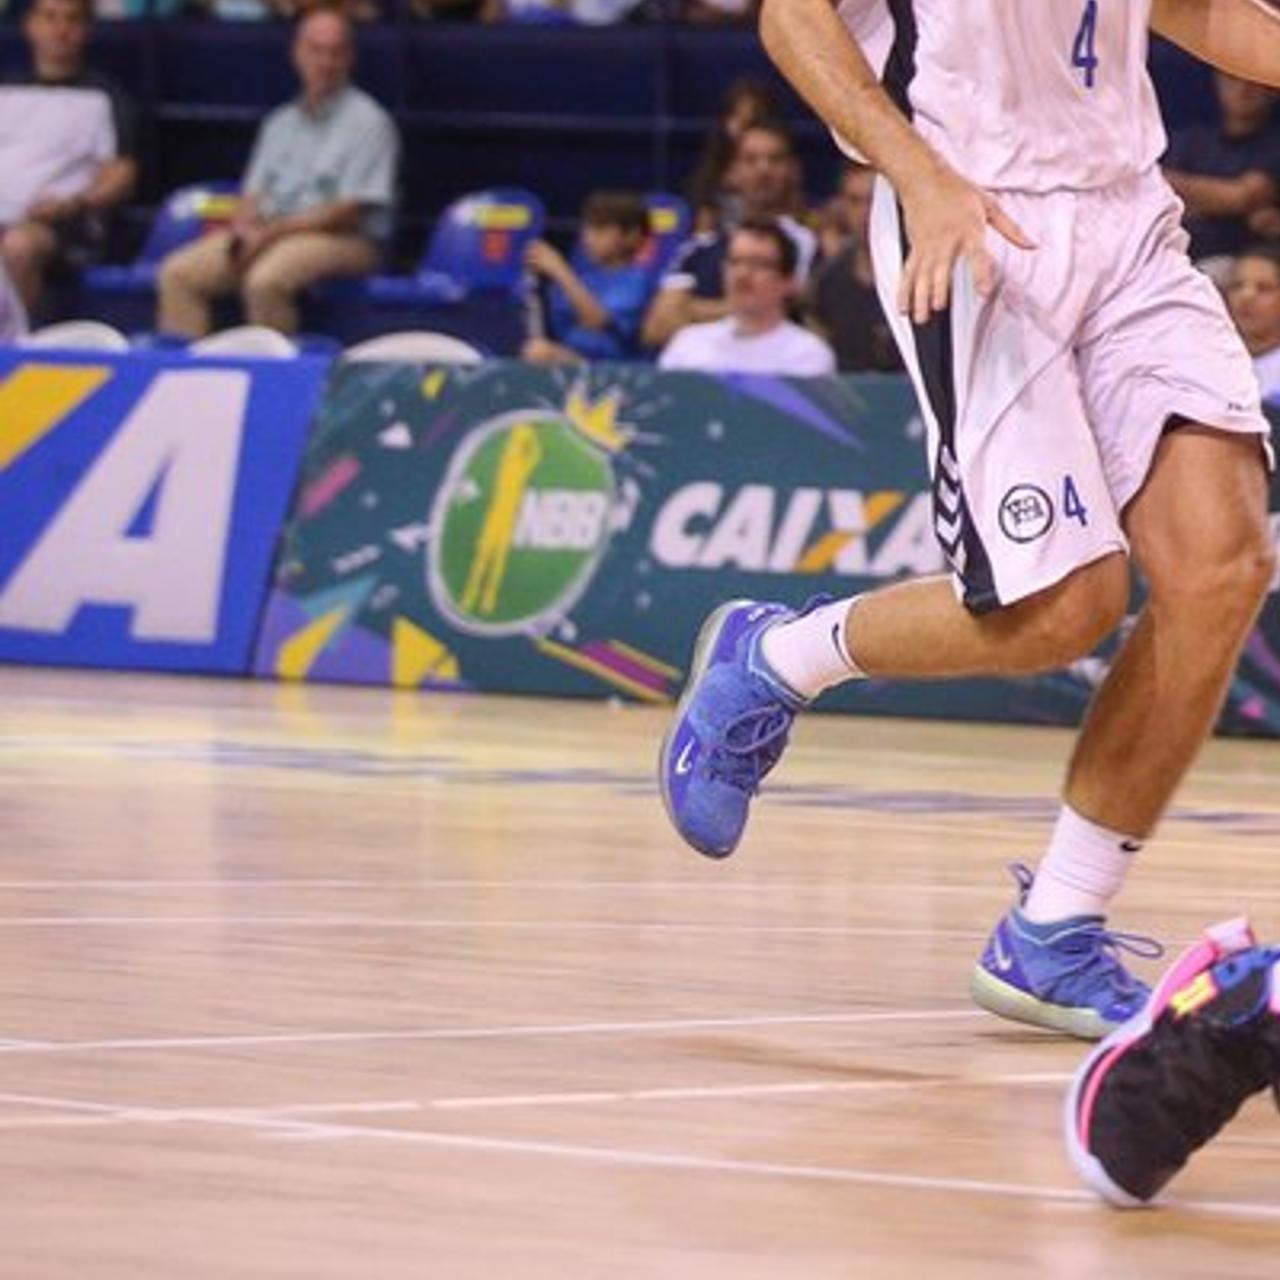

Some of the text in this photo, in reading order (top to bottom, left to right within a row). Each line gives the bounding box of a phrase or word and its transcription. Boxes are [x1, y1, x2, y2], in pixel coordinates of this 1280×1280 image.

[511, 489, 608, 551] NBB
[651, 480, 948, 576] CAIXA
[1063, 474, 1088, 527] 4
